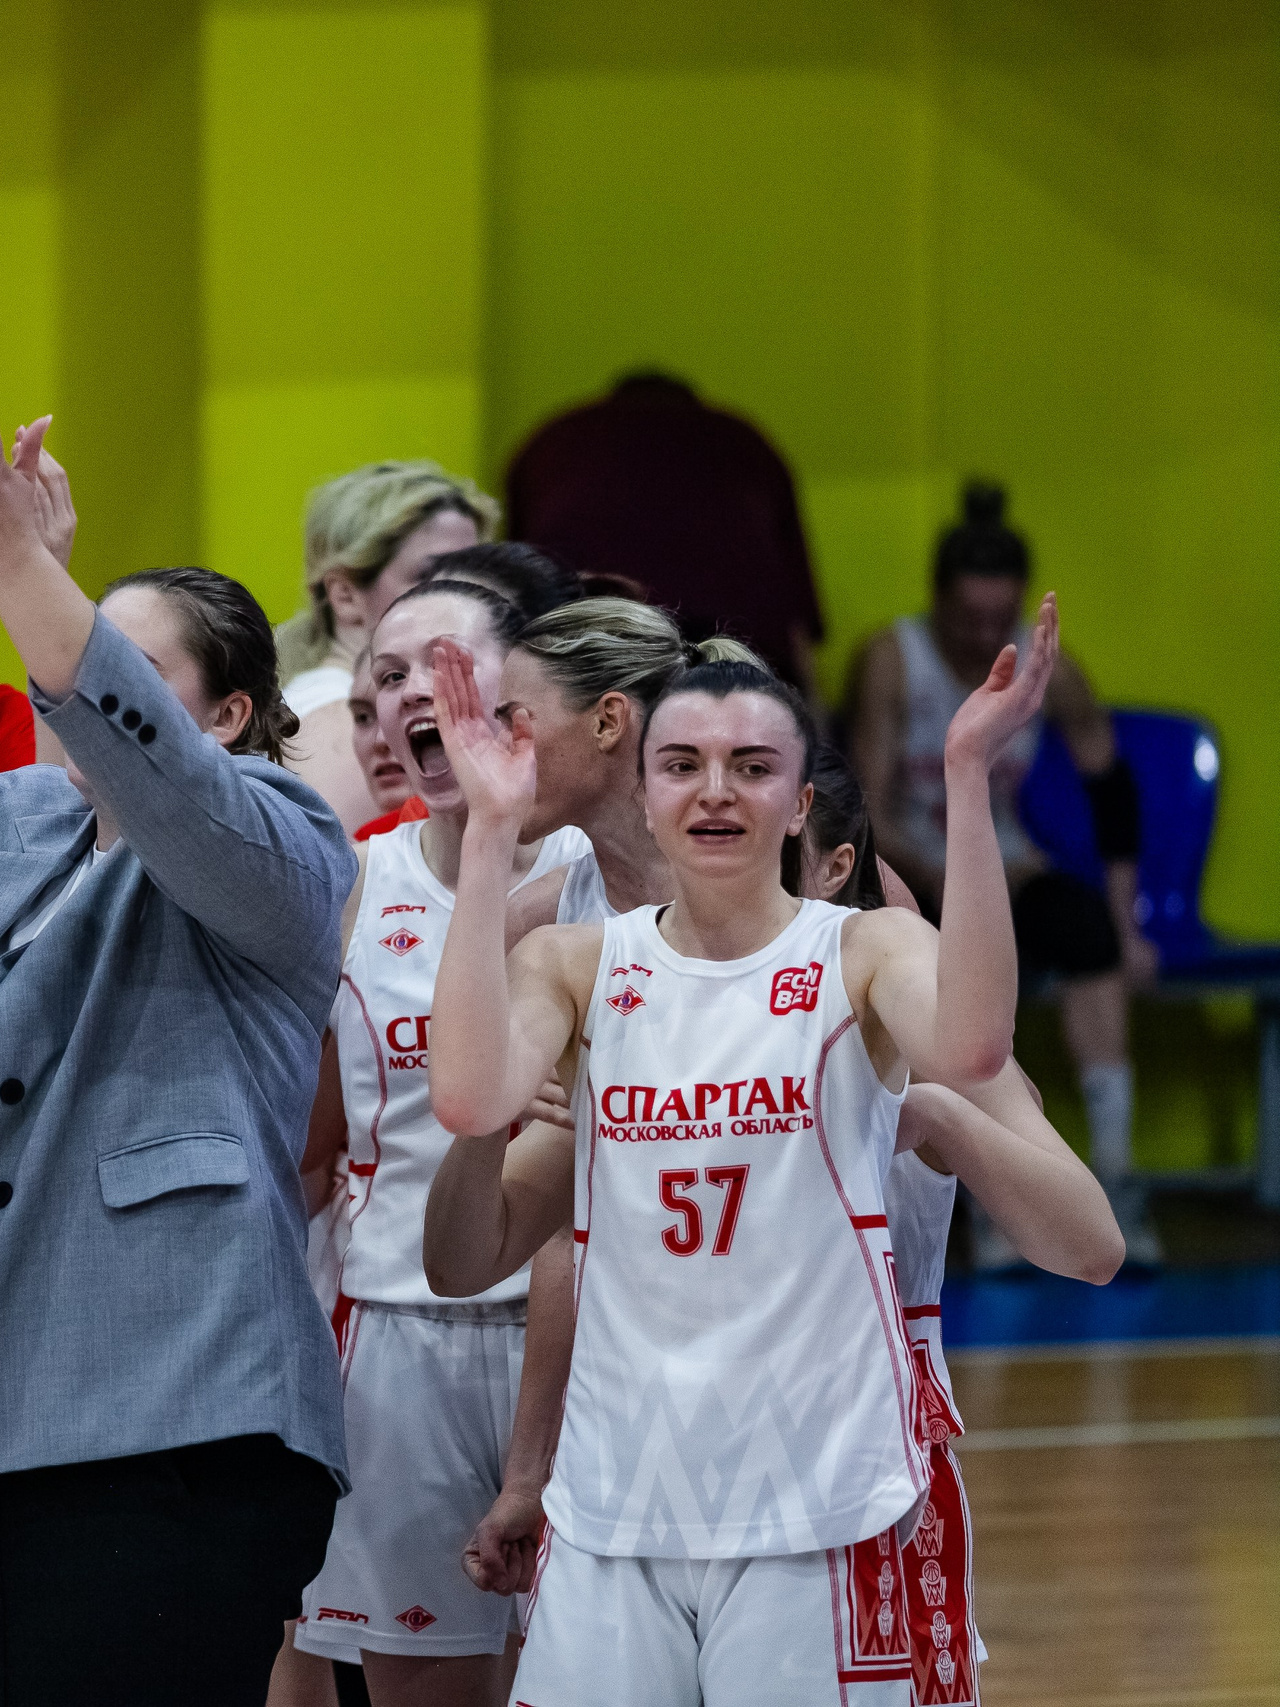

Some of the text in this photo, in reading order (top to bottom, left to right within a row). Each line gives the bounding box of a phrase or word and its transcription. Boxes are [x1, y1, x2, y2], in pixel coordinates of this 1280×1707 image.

[601, 1076, 811, 1124] СПАРТАК
[598, 1122, 722, 1142] МОСКОВСКАЯ
[658, 1164, 750, 1257] 57
